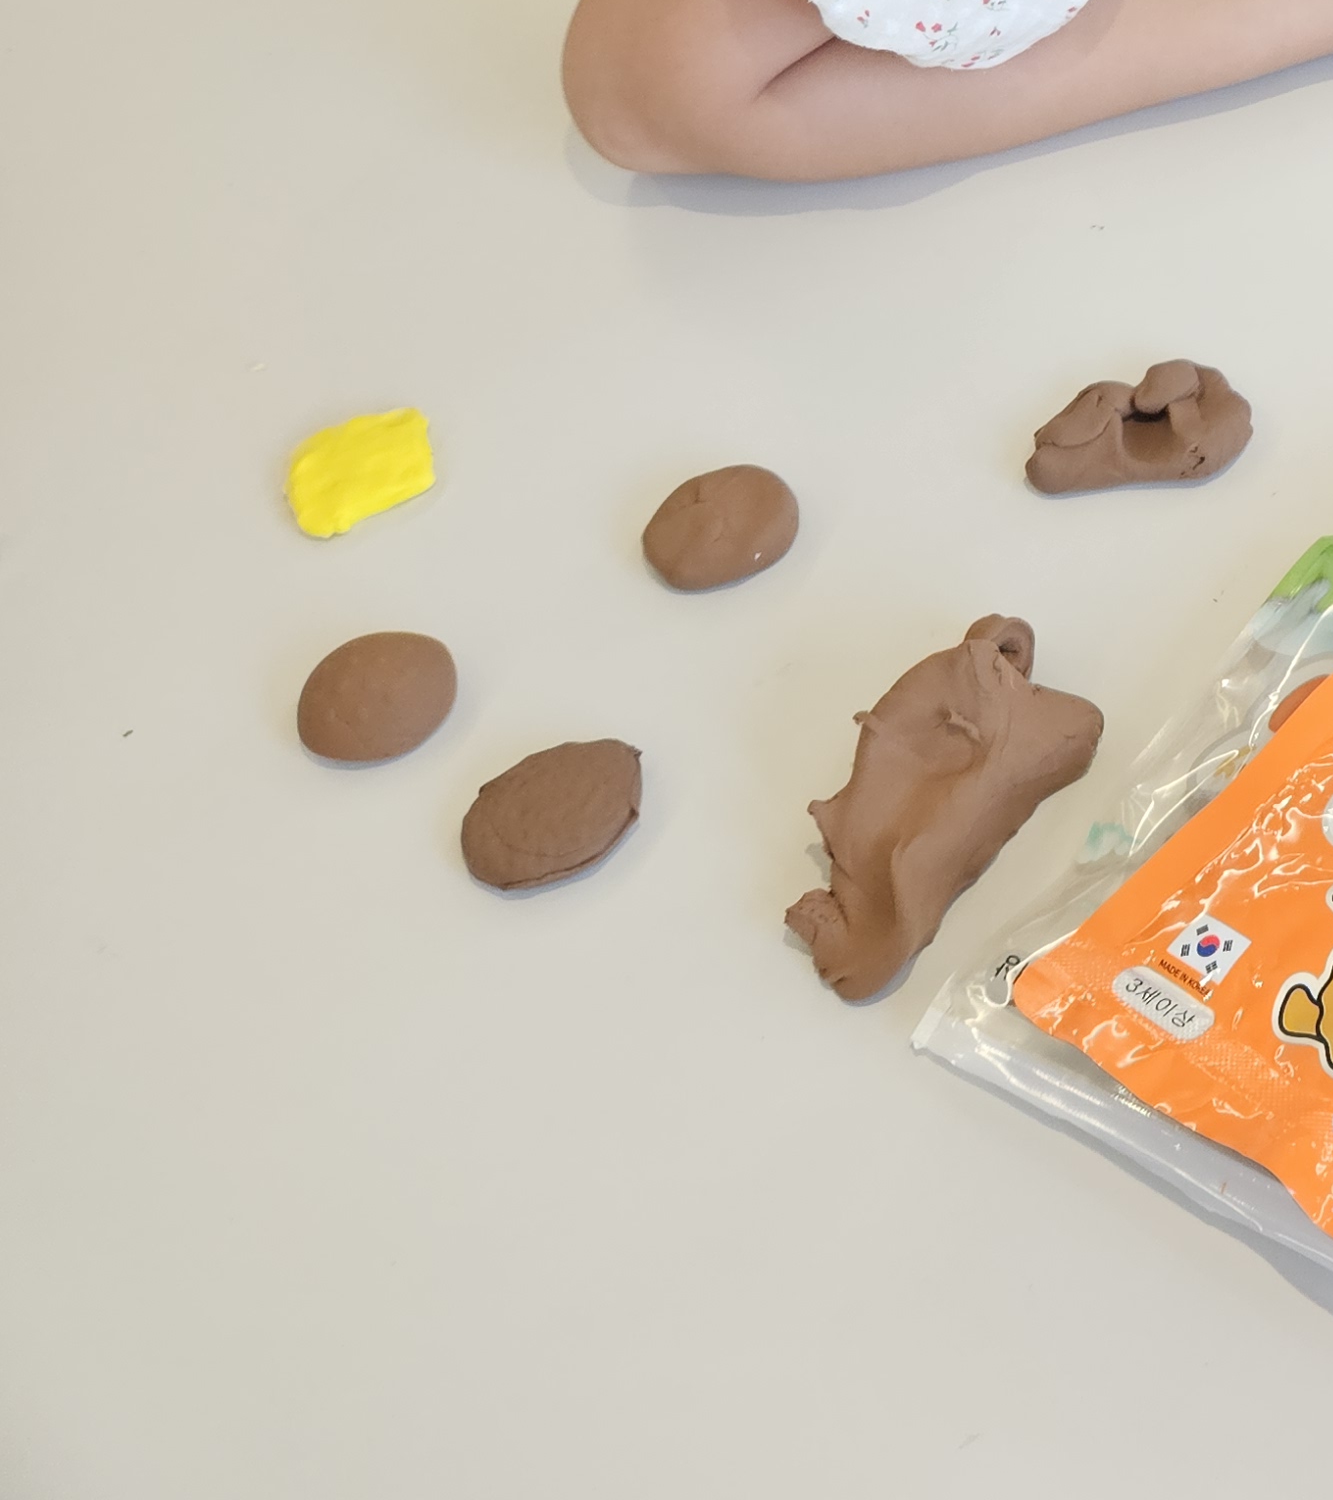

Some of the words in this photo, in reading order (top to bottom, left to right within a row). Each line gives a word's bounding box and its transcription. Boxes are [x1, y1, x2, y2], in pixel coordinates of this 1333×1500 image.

[1157, 958, 1181, 978] MADE
[1178, 972, 1188, 983] IN
[1186, 977, 1212, 998] KOREA
